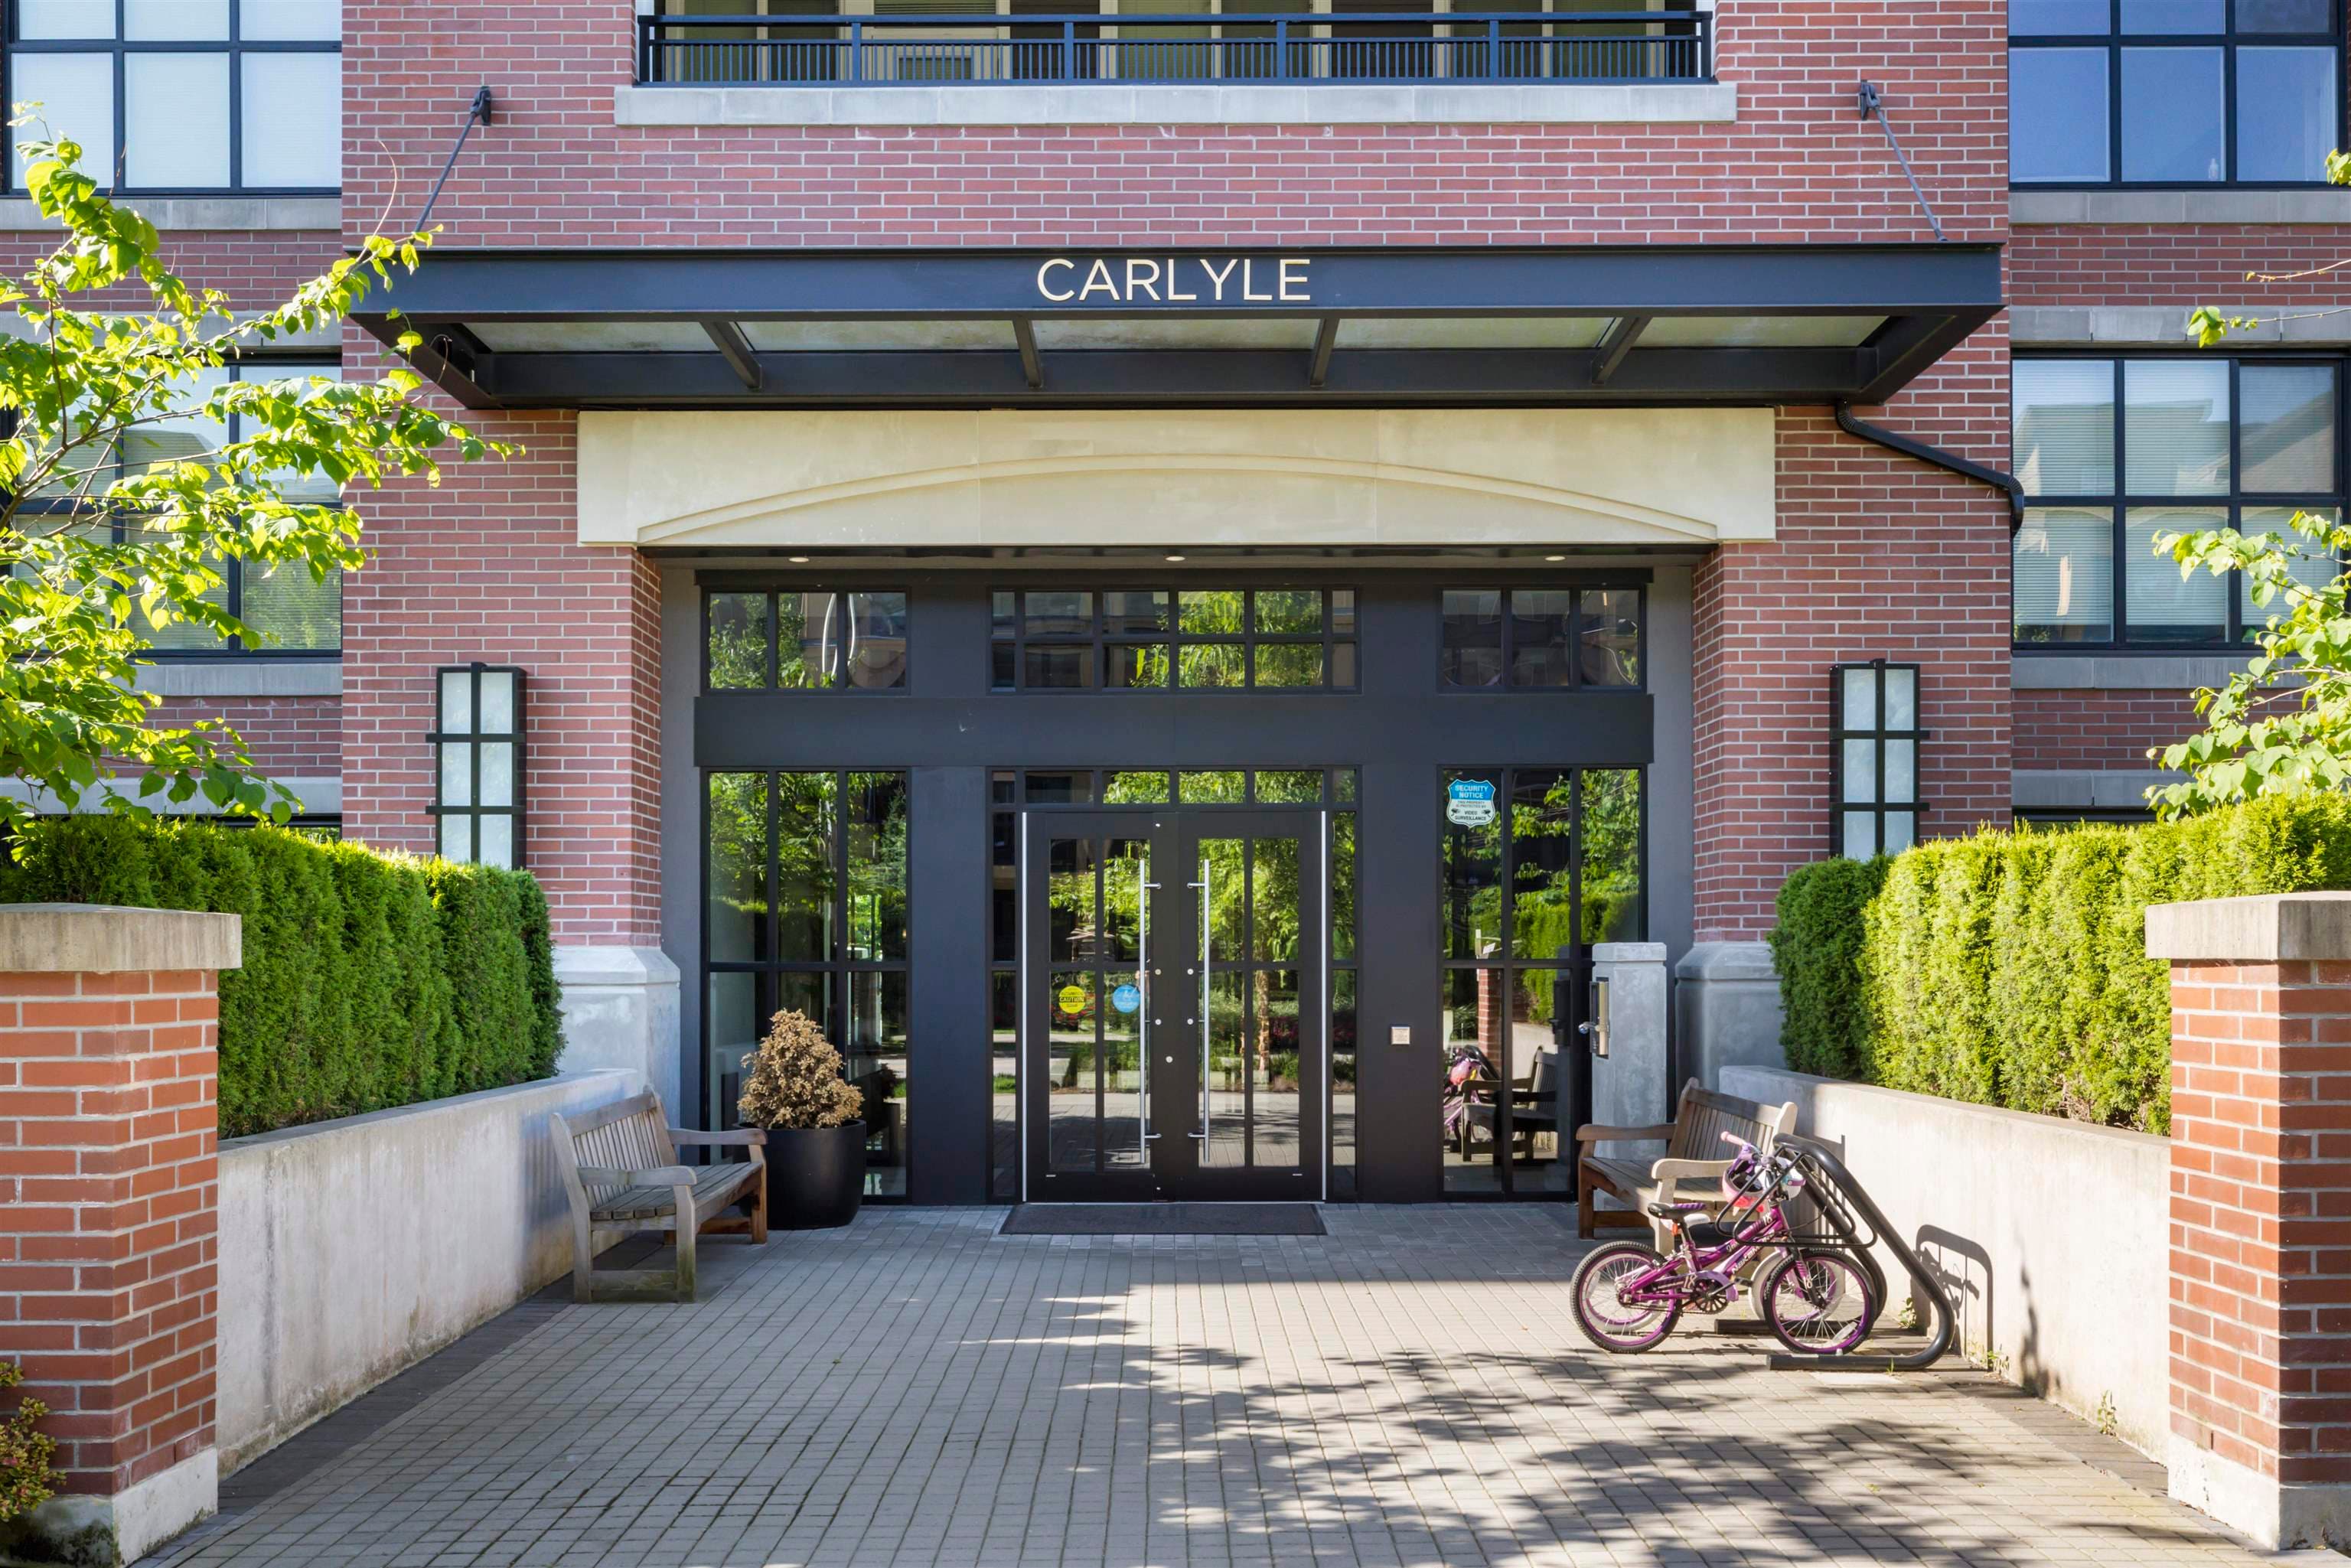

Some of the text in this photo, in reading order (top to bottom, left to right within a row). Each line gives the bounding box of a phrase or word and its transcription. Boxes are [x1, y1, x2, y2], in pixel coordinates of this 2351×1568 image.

[1037, 258, 1311, 302] CARLYLE
[1762, 1212, 1772, 1225] 18
[1684, 1274, 1697, 1289] 18
